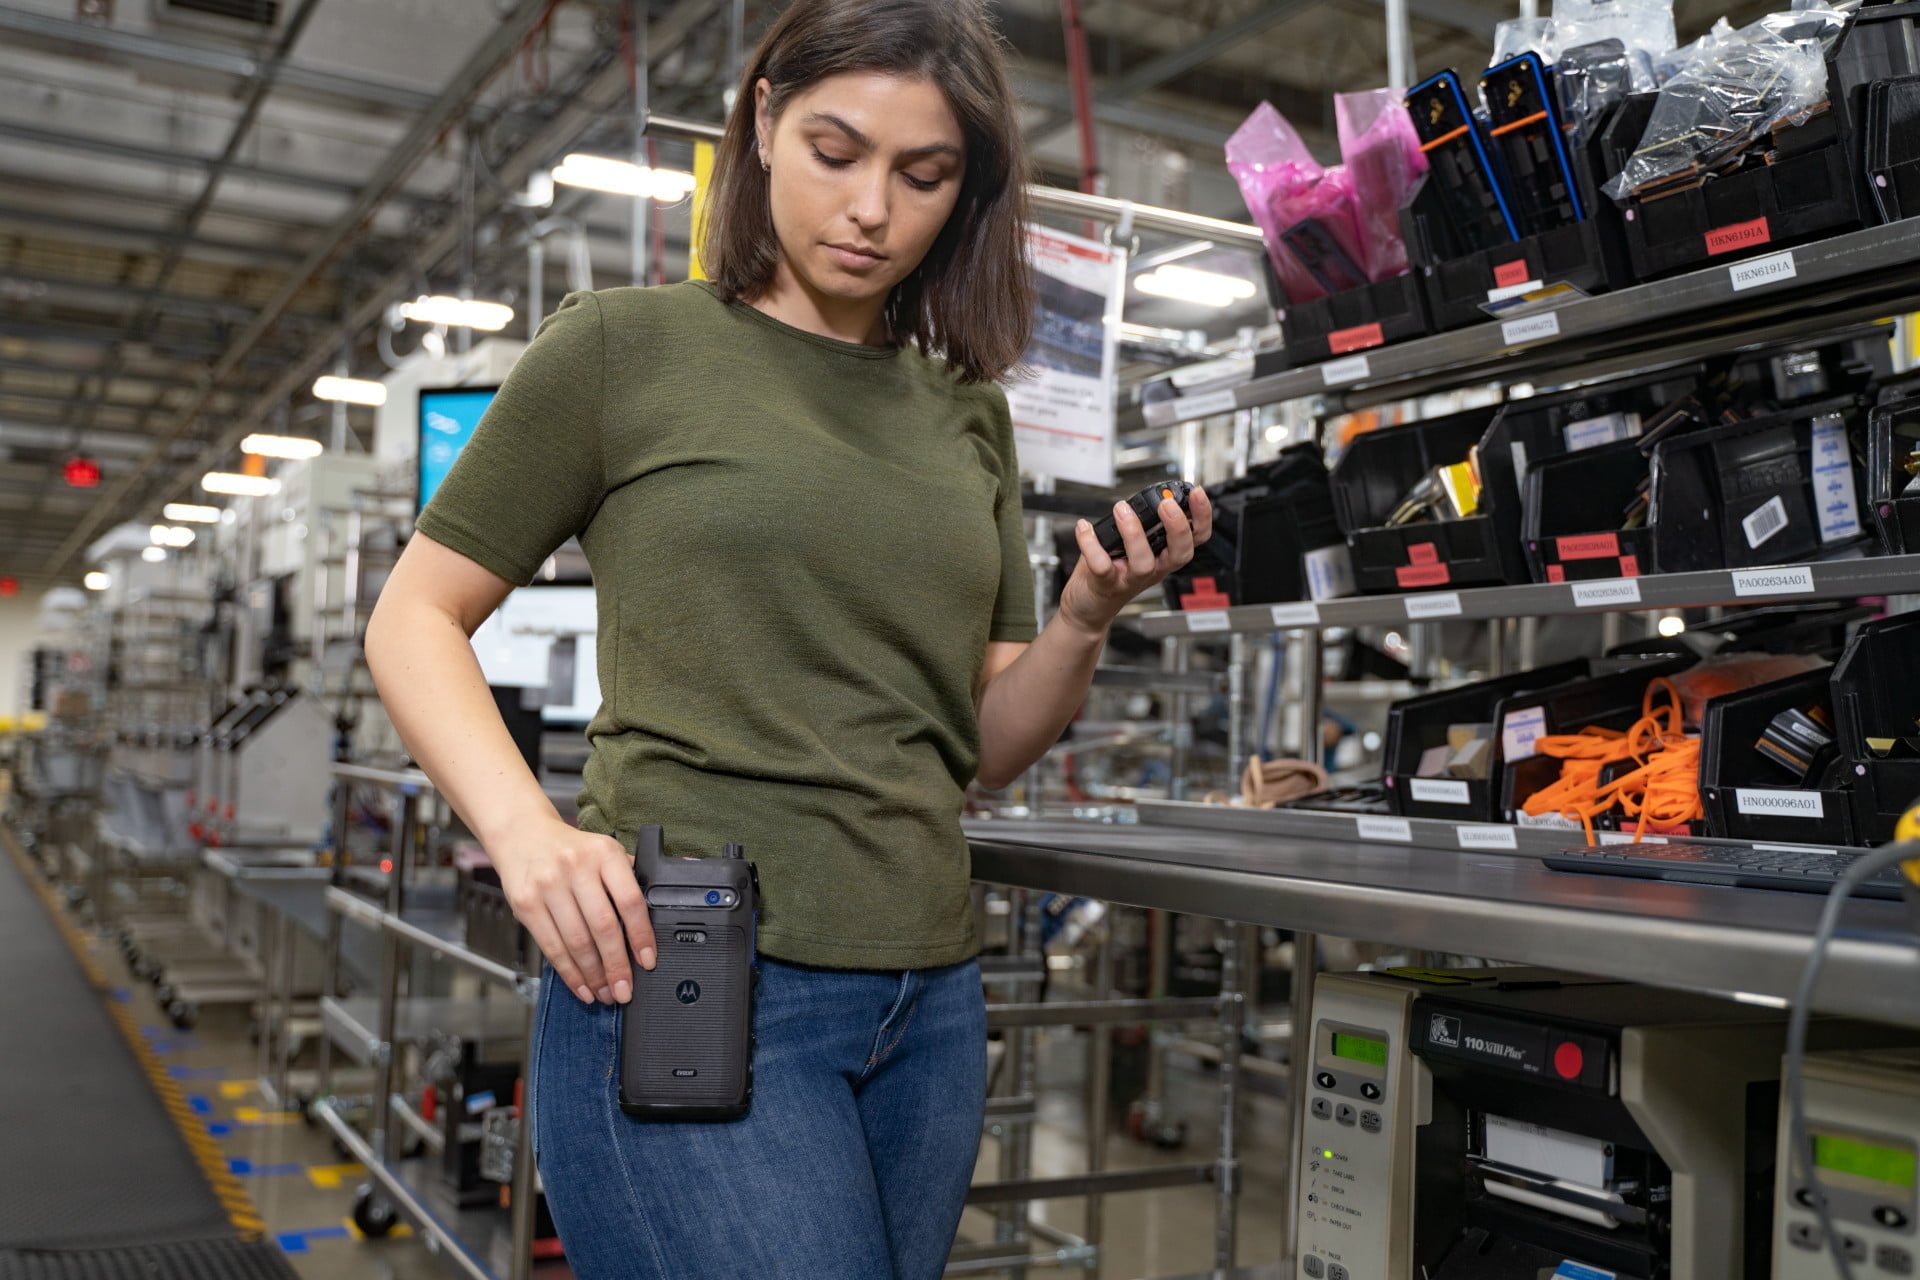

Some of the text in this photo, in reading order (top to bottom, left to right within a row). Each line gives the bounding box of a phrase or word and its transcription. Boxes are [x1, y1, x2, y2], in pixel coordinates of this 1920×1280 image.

[1710, 227, 1763, 247] HKN6191A
[1736, 261, 1790, 282] HKN6191A
[1738, 575, 1808, 588] PA002634A01
[1743, 796, 1817, 810] HN000096A01
[1439, 1036, 1457, 1045] Zebra
